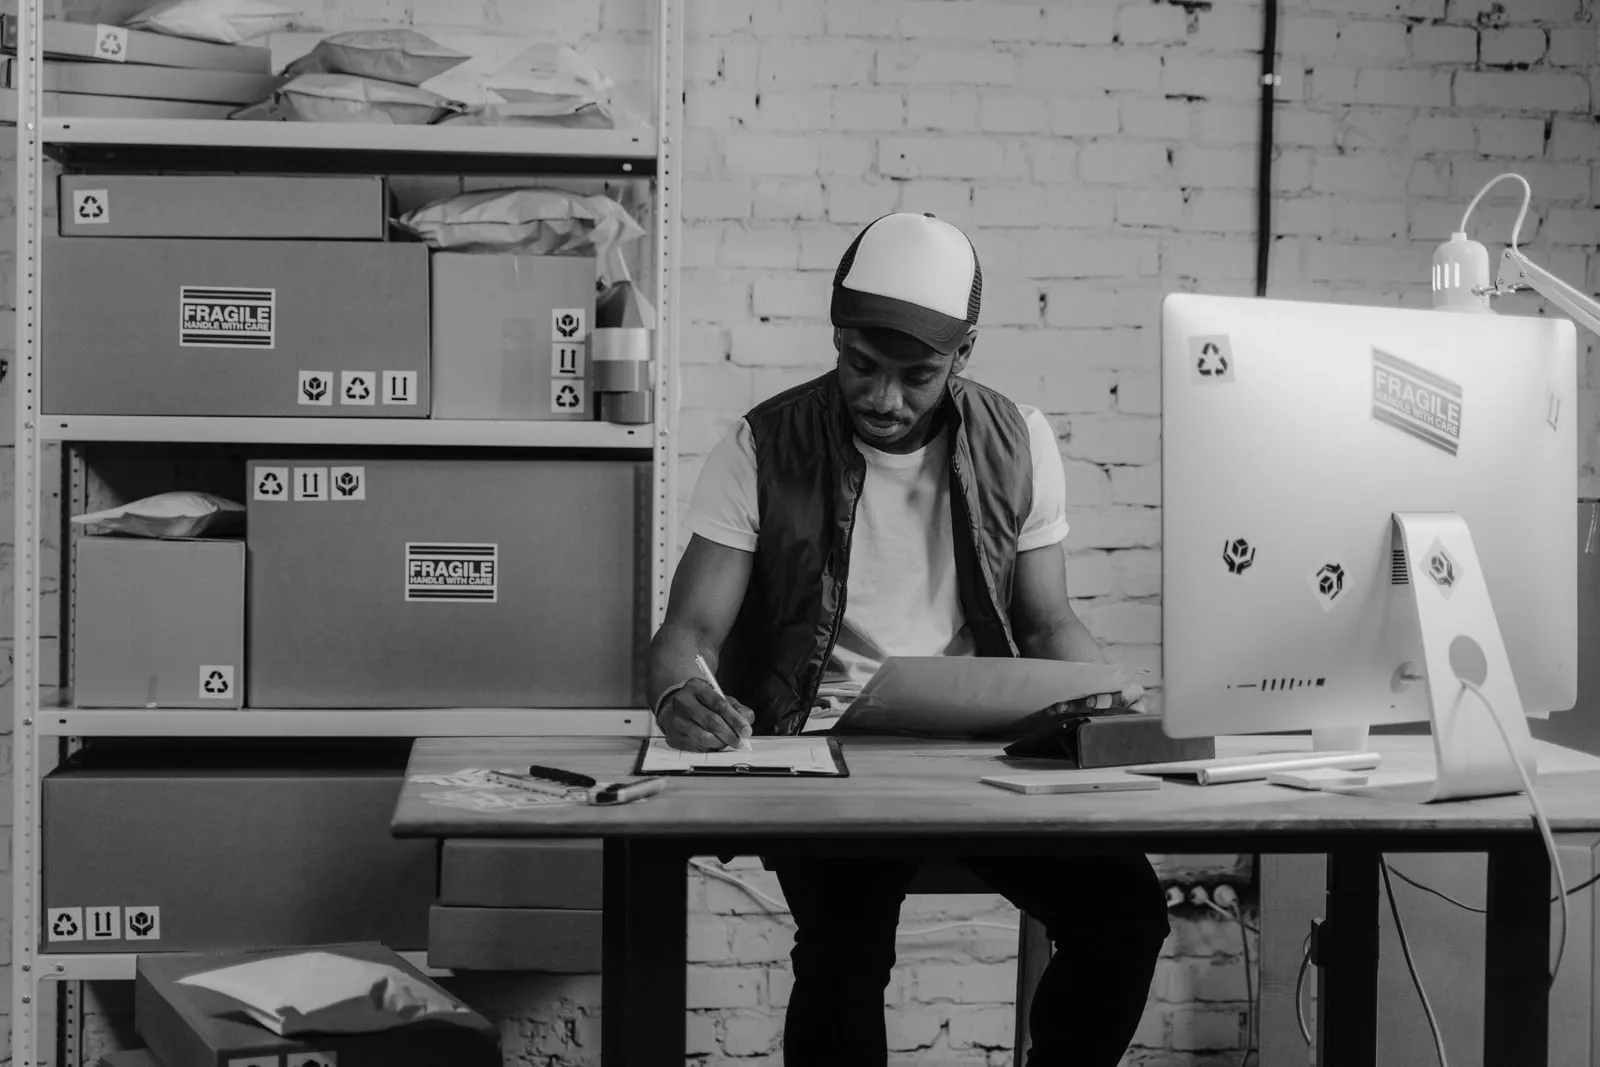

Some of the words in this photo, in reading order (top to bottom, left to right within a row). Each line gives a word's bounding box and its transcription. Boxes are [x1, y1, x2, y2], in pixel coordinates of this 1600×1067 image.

[184, 304, 270, 323] FRAGILE
[184, 321, 220, 329] HANDLE
[221, 322, 243, 330] WITH
[245, 322, 270, 331] CARE
[1375, 369, 1460, 426] FRAGILE
[1412, 406, 1434, 425] WITH
[1435, 417, 1458, 436] CARE
[410, 561, 493, 578] FRAGILE
[410, 577, 445, 585] HANDLE
[446, 577, 467, 585] WITH
[468, 577, 493, 585] CARE
